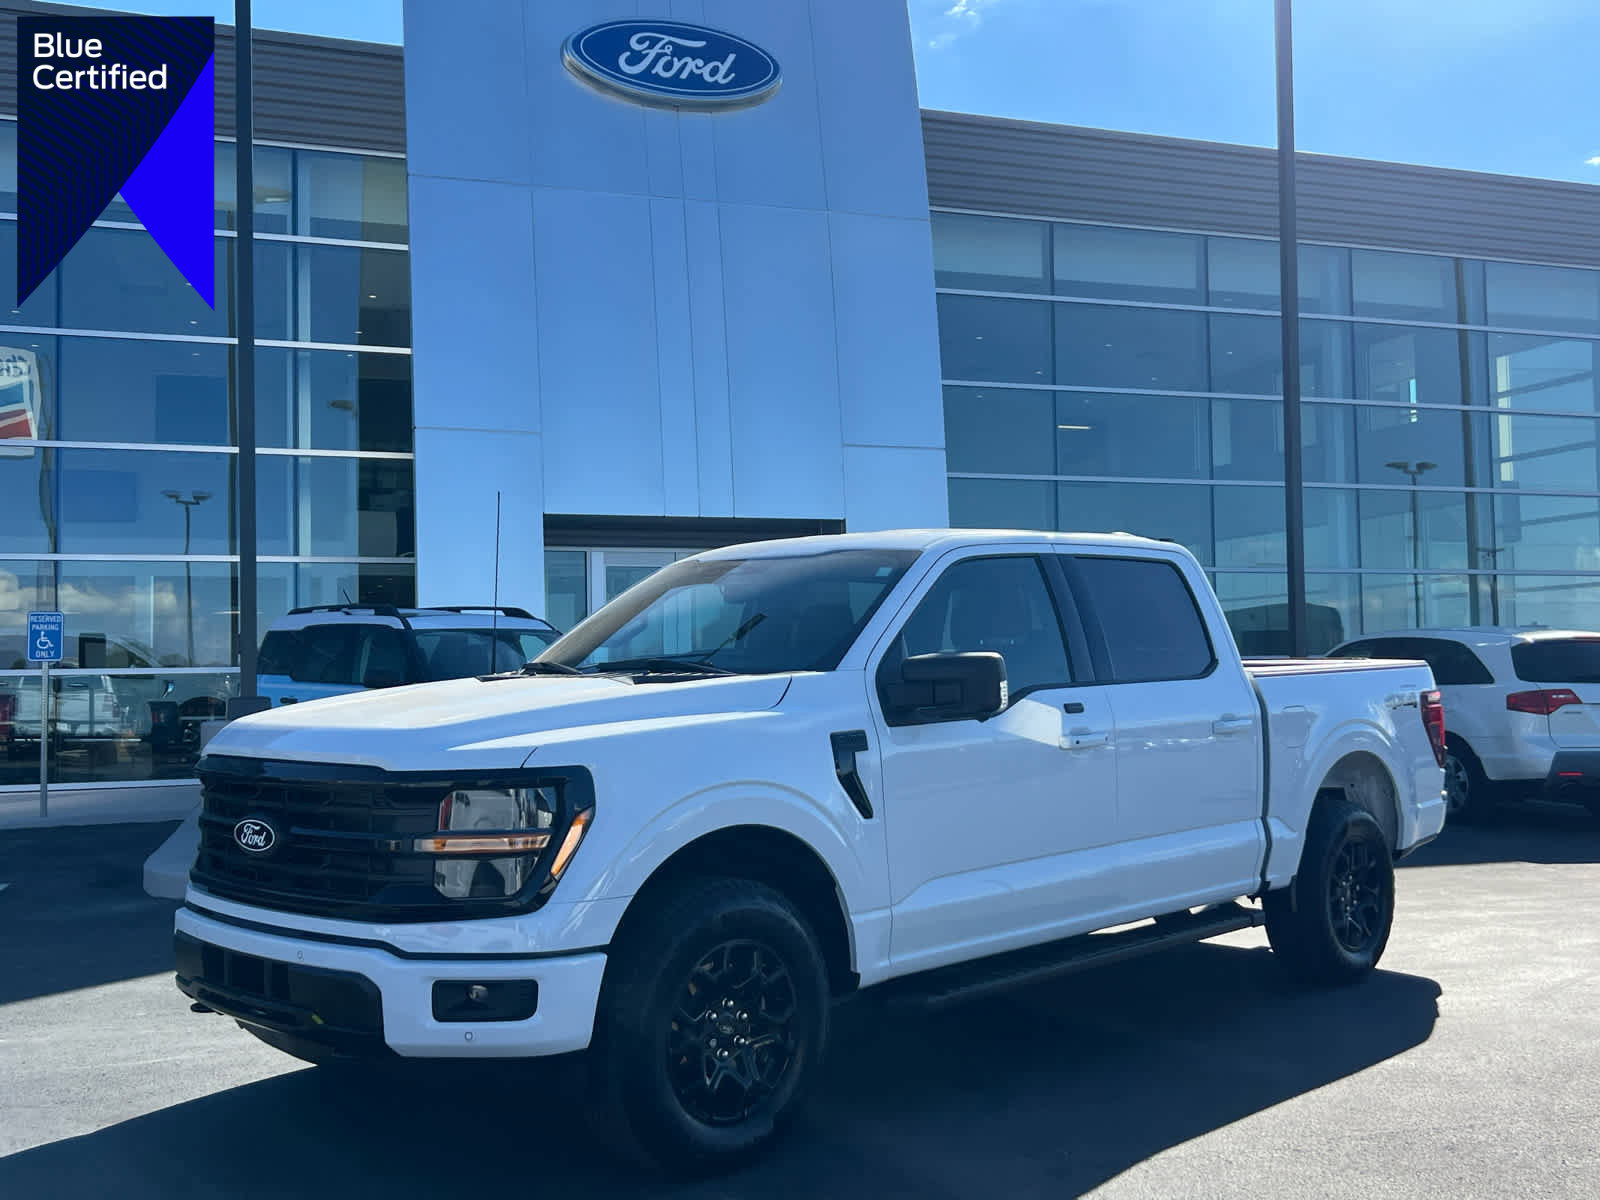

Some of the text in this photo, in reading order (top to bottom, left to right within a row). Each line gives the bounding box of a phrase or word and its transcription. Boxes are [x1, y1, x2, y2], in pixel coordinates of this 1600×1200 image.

[618, 32, 737, 84] Ford
[35, 650, 55, 658] ONLY
[241, 823, 267, 847] Ford
